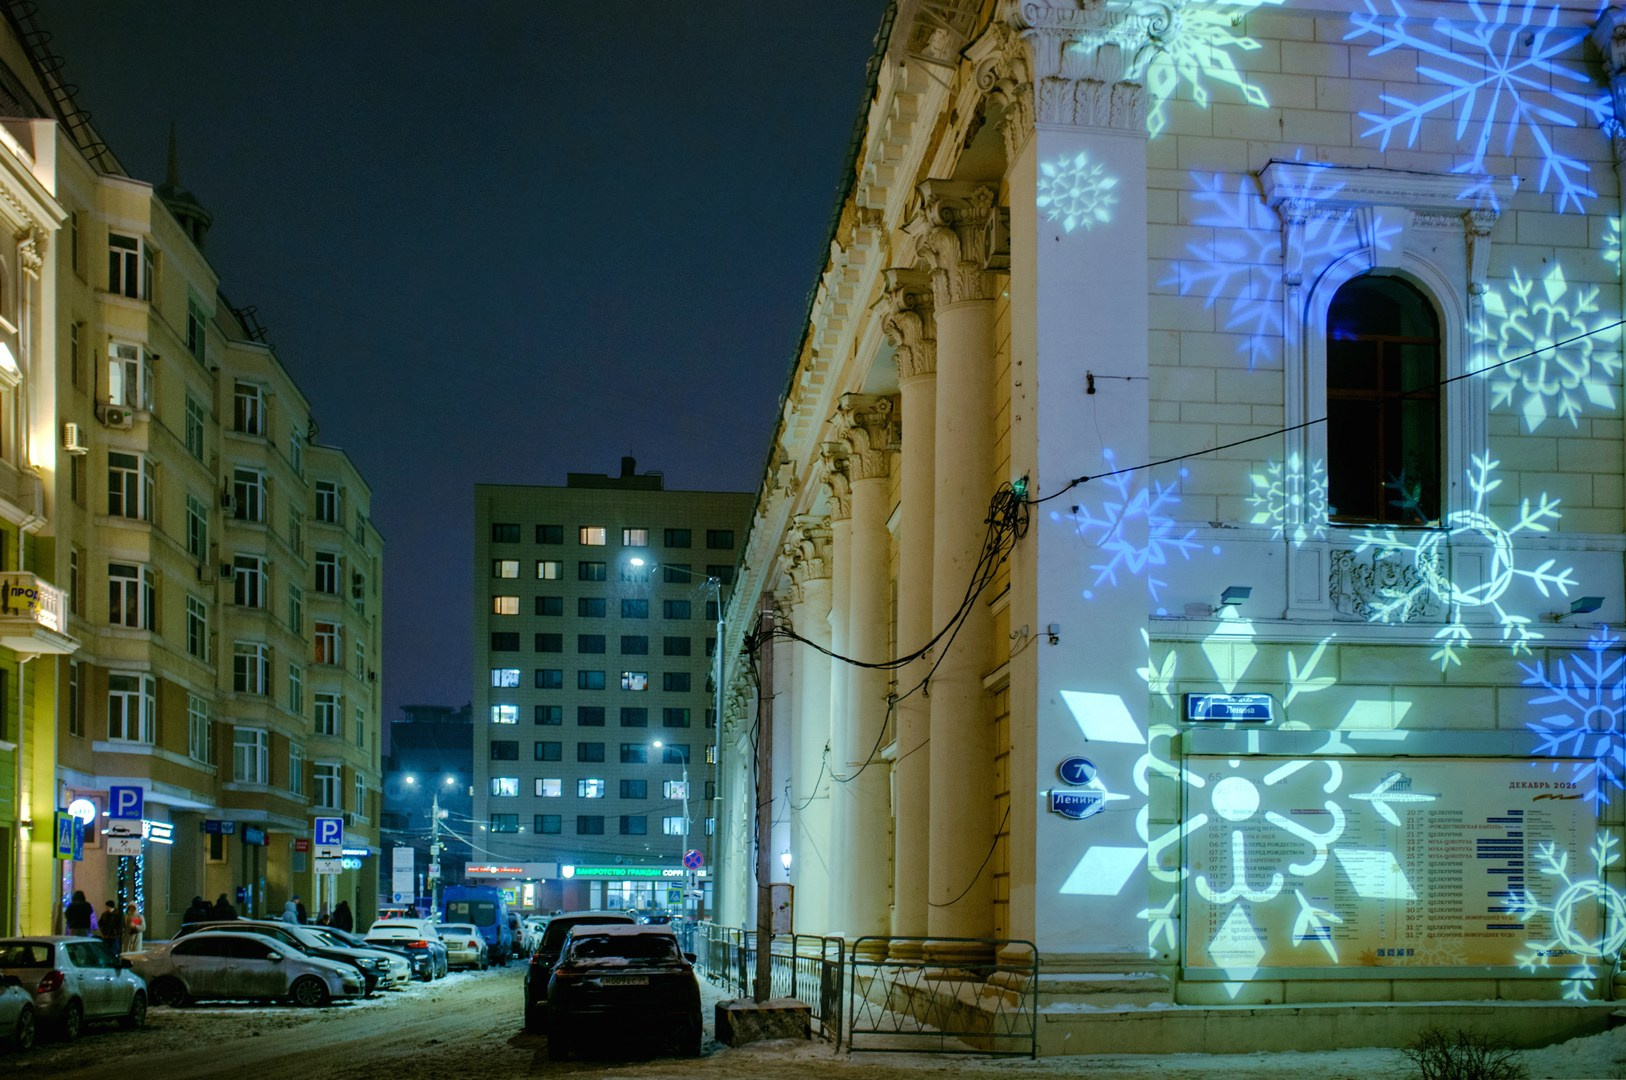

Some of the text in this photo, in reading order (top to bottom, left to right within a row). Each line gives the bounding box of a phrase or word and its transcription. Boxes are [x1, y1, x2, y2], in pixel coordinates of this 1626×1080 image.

[1197, 701, 1204, 712] 7
[1226, 706, 1254, 714] Ленина
[1074, 764, 1083, 778] 7
[1208, 772, 1222, 782] 65
[1056, 795, 1102, 804] Ленина
[576, 868, 626, 876] БАНКРОТСТВО
